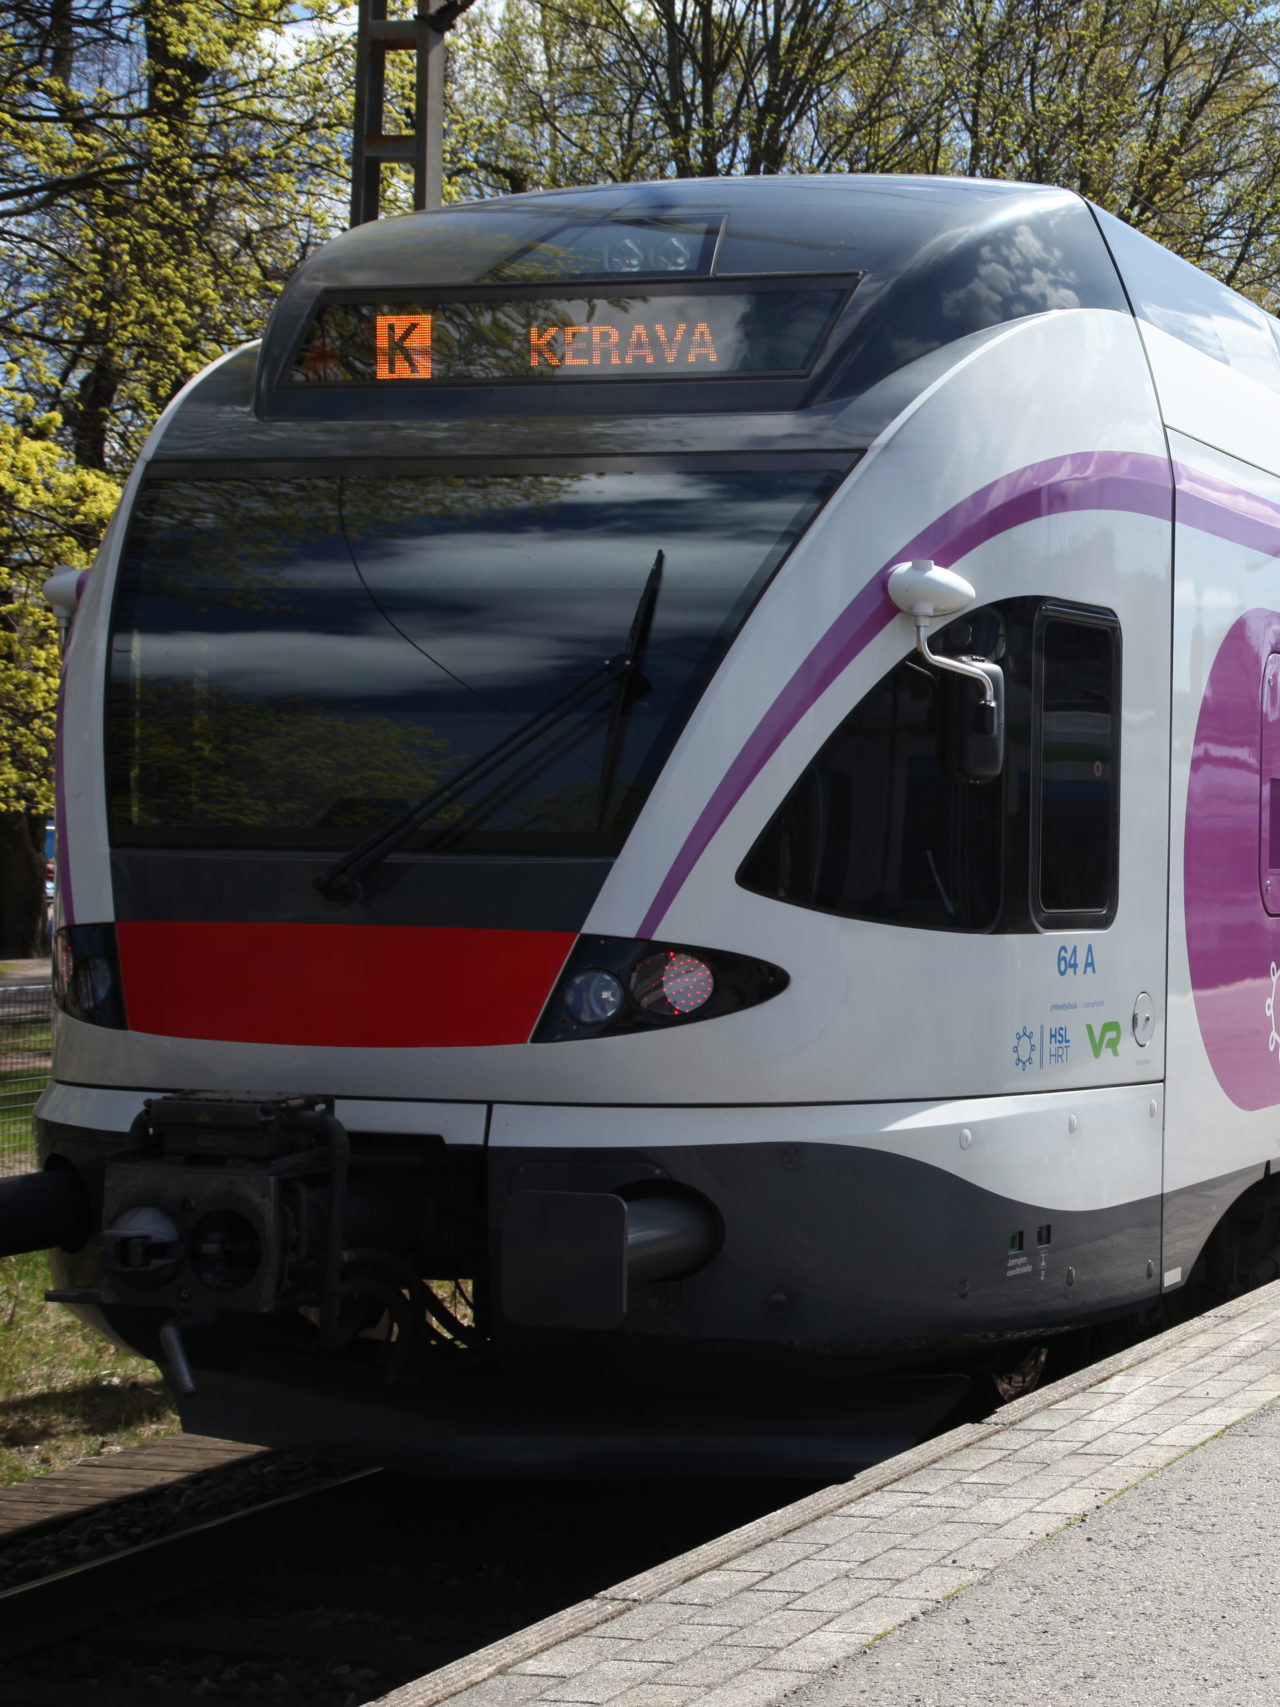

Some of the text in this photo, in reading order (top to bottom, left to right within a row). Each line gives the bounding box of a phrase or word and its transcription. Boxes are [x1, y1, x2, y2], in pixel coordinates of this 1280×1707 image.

[387, 322, 717, 375] K KERAVA
[1057, 943, 1096, 977] 64 A
[1049, 1025, 1071, 1045] HSL
[1086, 1020, 1122, 1060] VR
[1049, 1045, 1071, 1065] HRT
